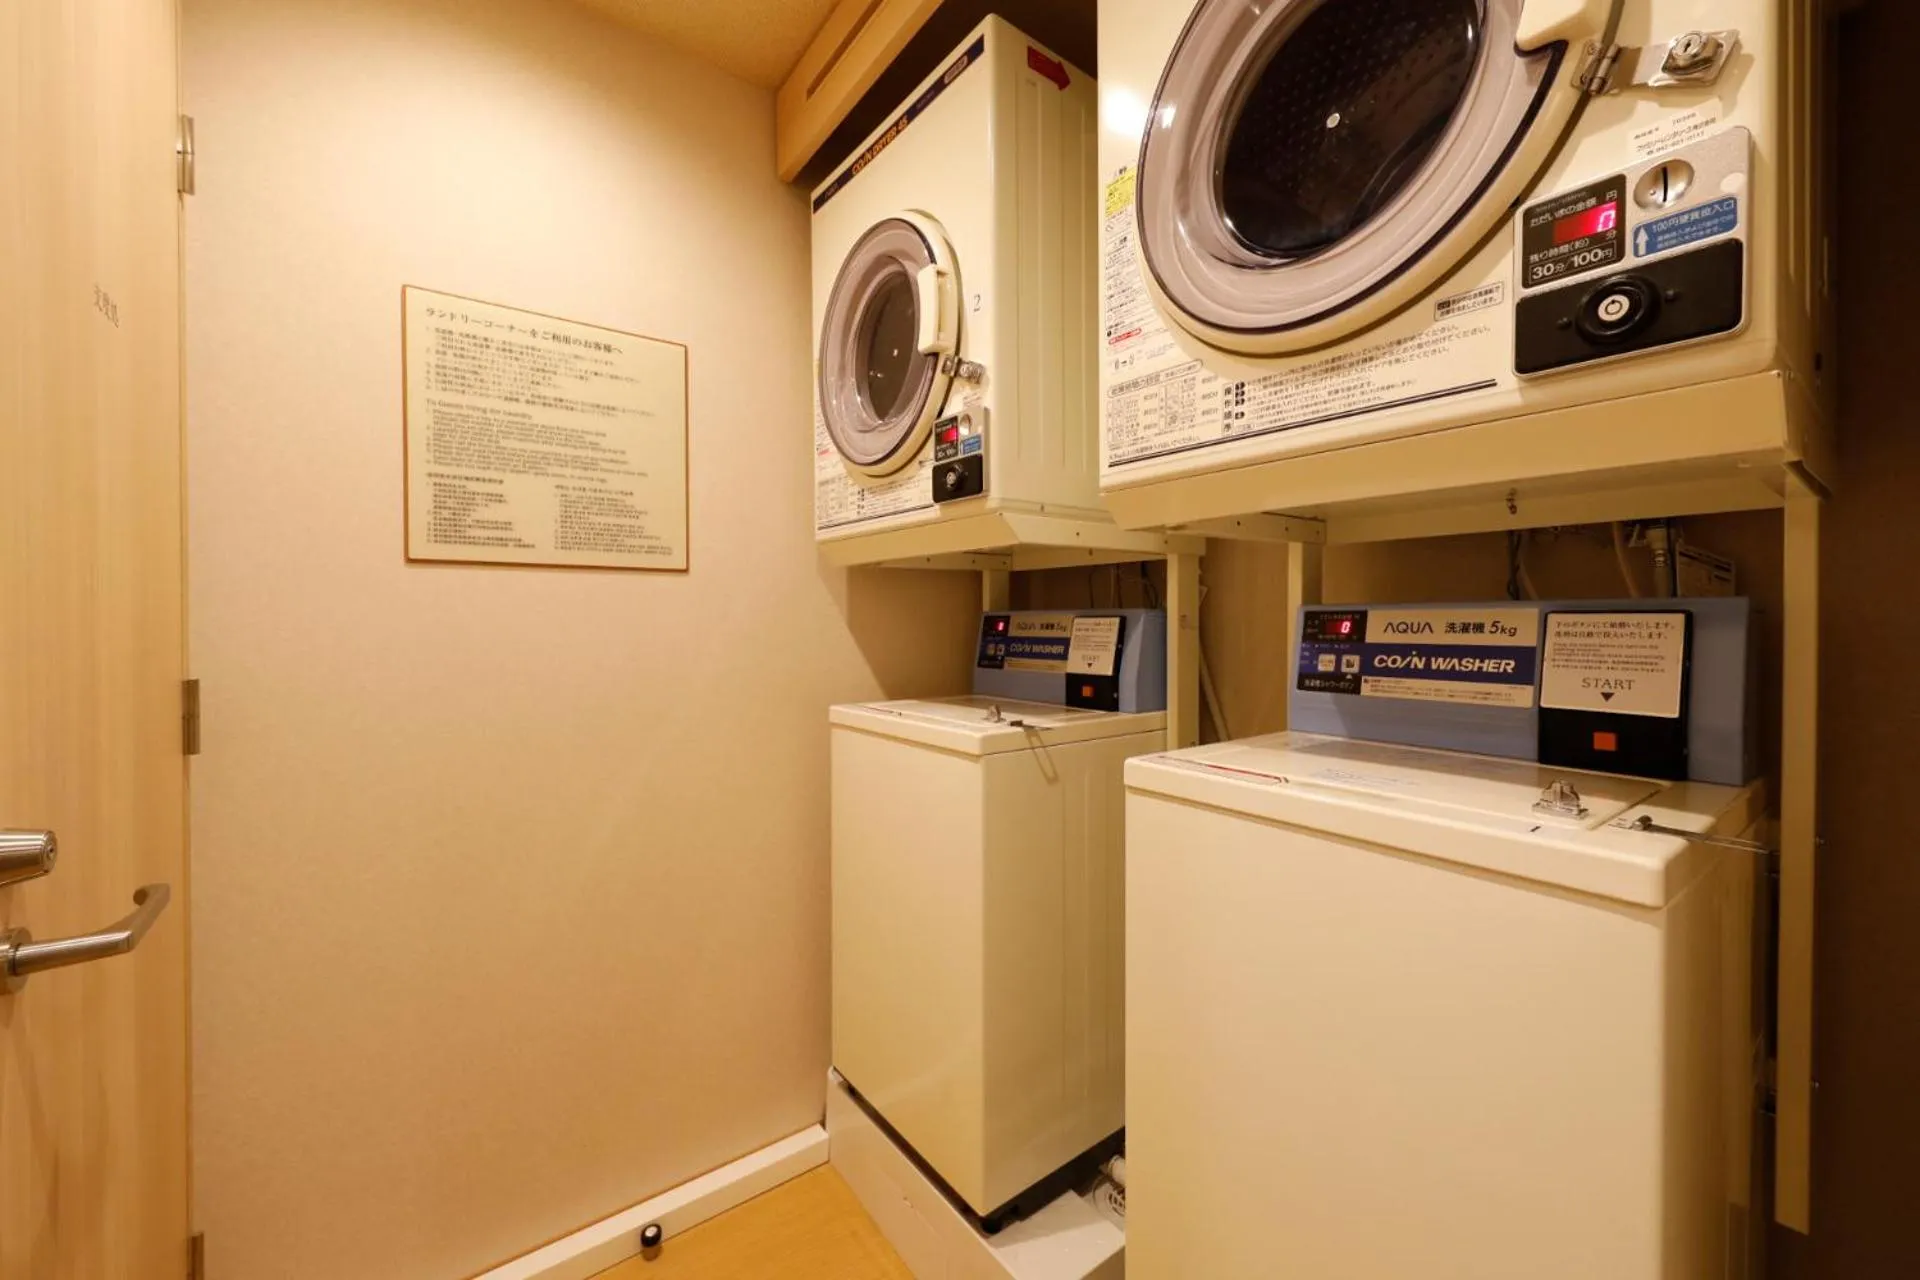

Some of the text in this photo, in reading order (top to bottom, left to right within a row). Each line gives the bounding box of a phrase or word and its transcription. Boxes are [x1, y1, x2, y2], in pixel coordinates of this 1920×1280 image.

[1596, 209, 1617, 234] 0
[1383, 620, 1518, 637] AQUA 洗濯機 5kg
[1373, 650, 1516, 673] COIN WASHER
[1581, 677, 1636, 690] START
